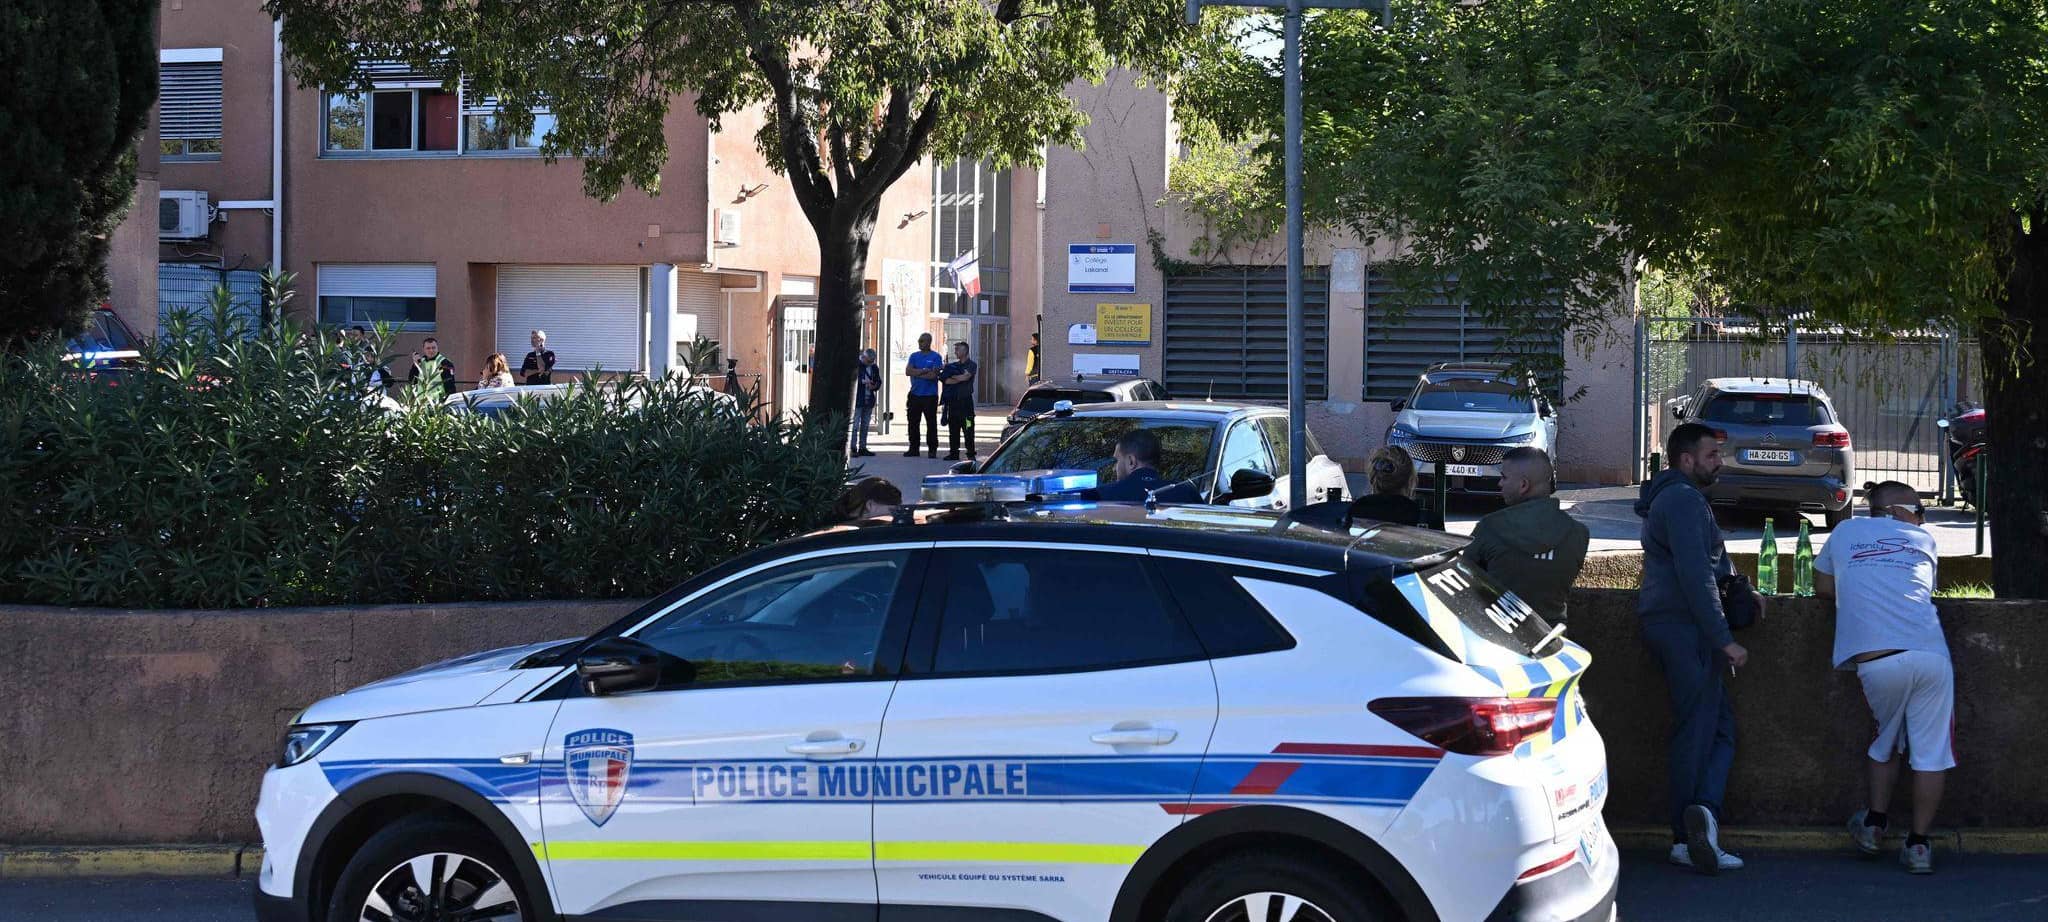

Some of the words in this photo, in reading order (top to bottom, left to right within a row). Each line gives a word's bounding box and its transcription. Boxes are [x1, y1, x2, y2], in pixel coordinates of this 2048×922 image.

[569, 732, 628, 746] POLICE
[569, 750, 628, 762] MUNICIPALE
[695, 764, 808, 797] POLICE
[818, 763, 1026, 797] MUNICIPALE
